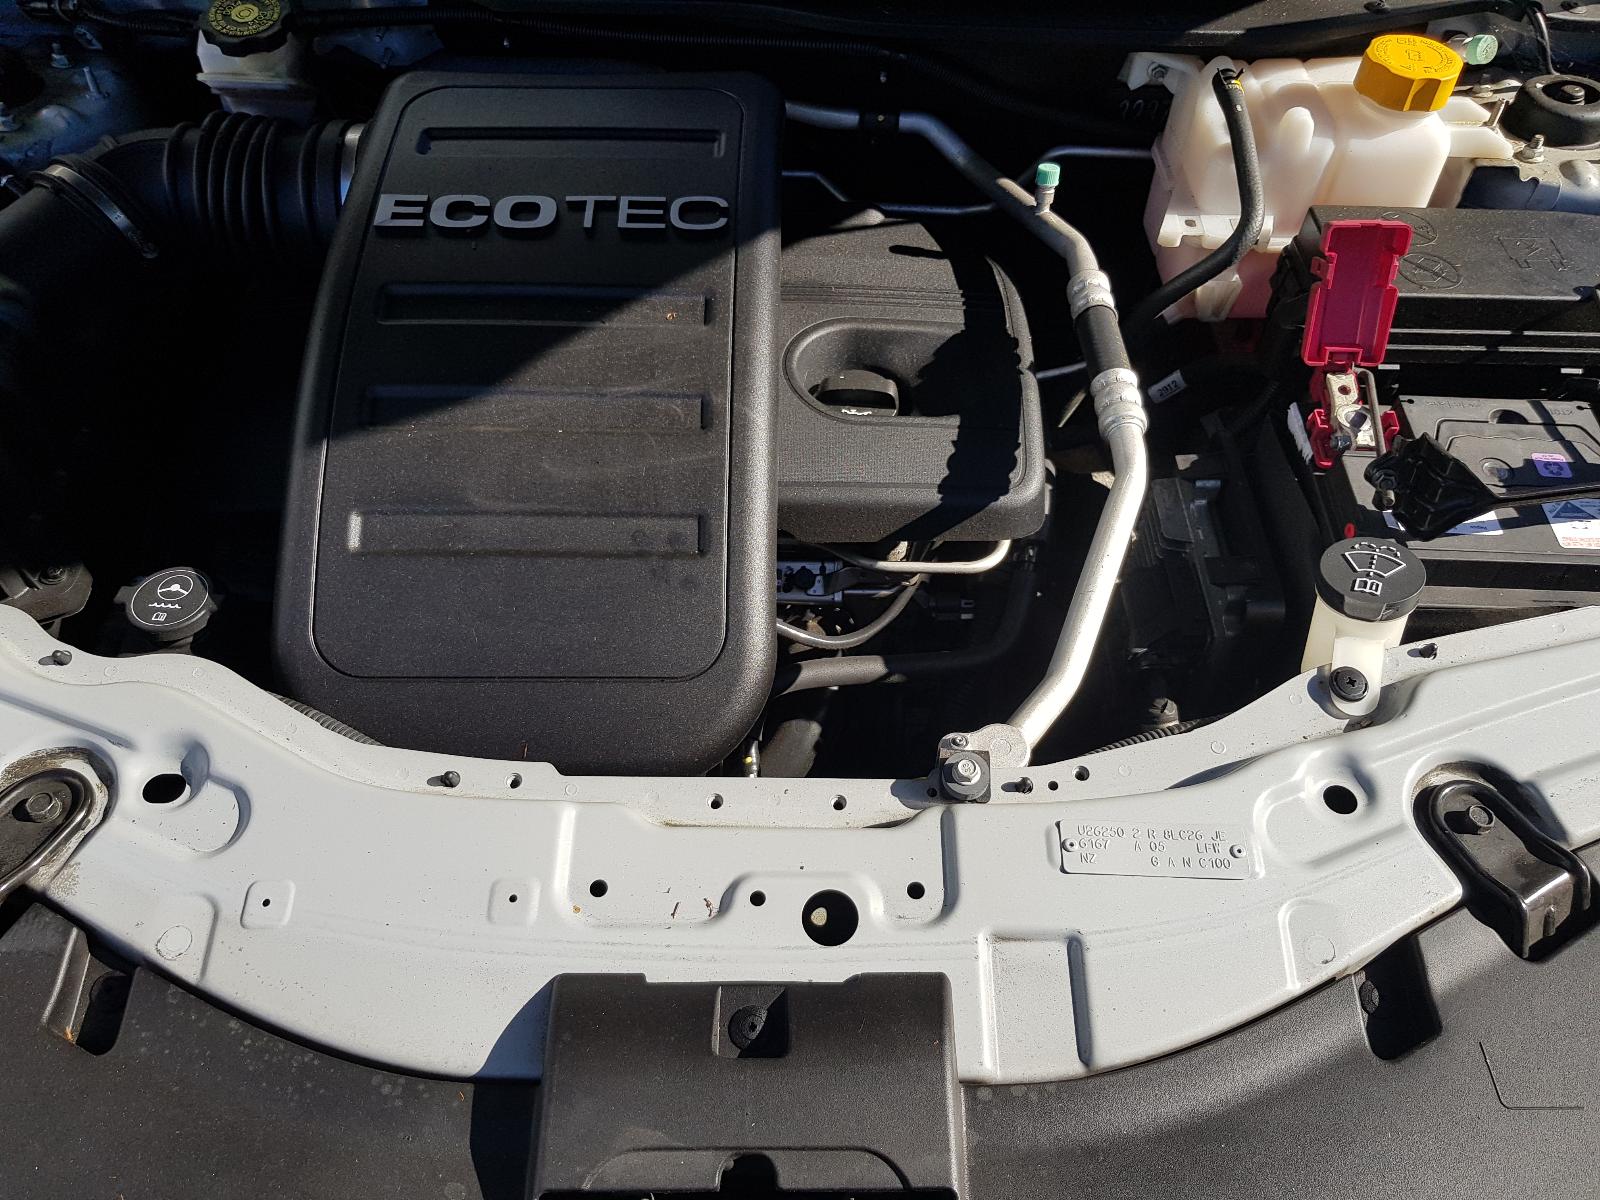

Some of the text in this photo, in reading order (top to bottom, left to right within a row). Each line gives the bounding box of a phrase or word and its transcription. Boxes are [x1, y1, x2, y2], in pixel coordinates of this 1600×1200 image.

[373, 194, 730, 231] ECOTEC
[1132, 827, 1140, 839] 2
[1147, 828, 1156, 840] R
[1211, 830, 1226, 842] JE
[1134, 840, 1142, 852] A
[1080, 852, 1096, 864] NZ
[1168, 857, 1176, 868] A
[1182, 857, 1191, 868] N
[1198, 857, 1231, 870] C100
